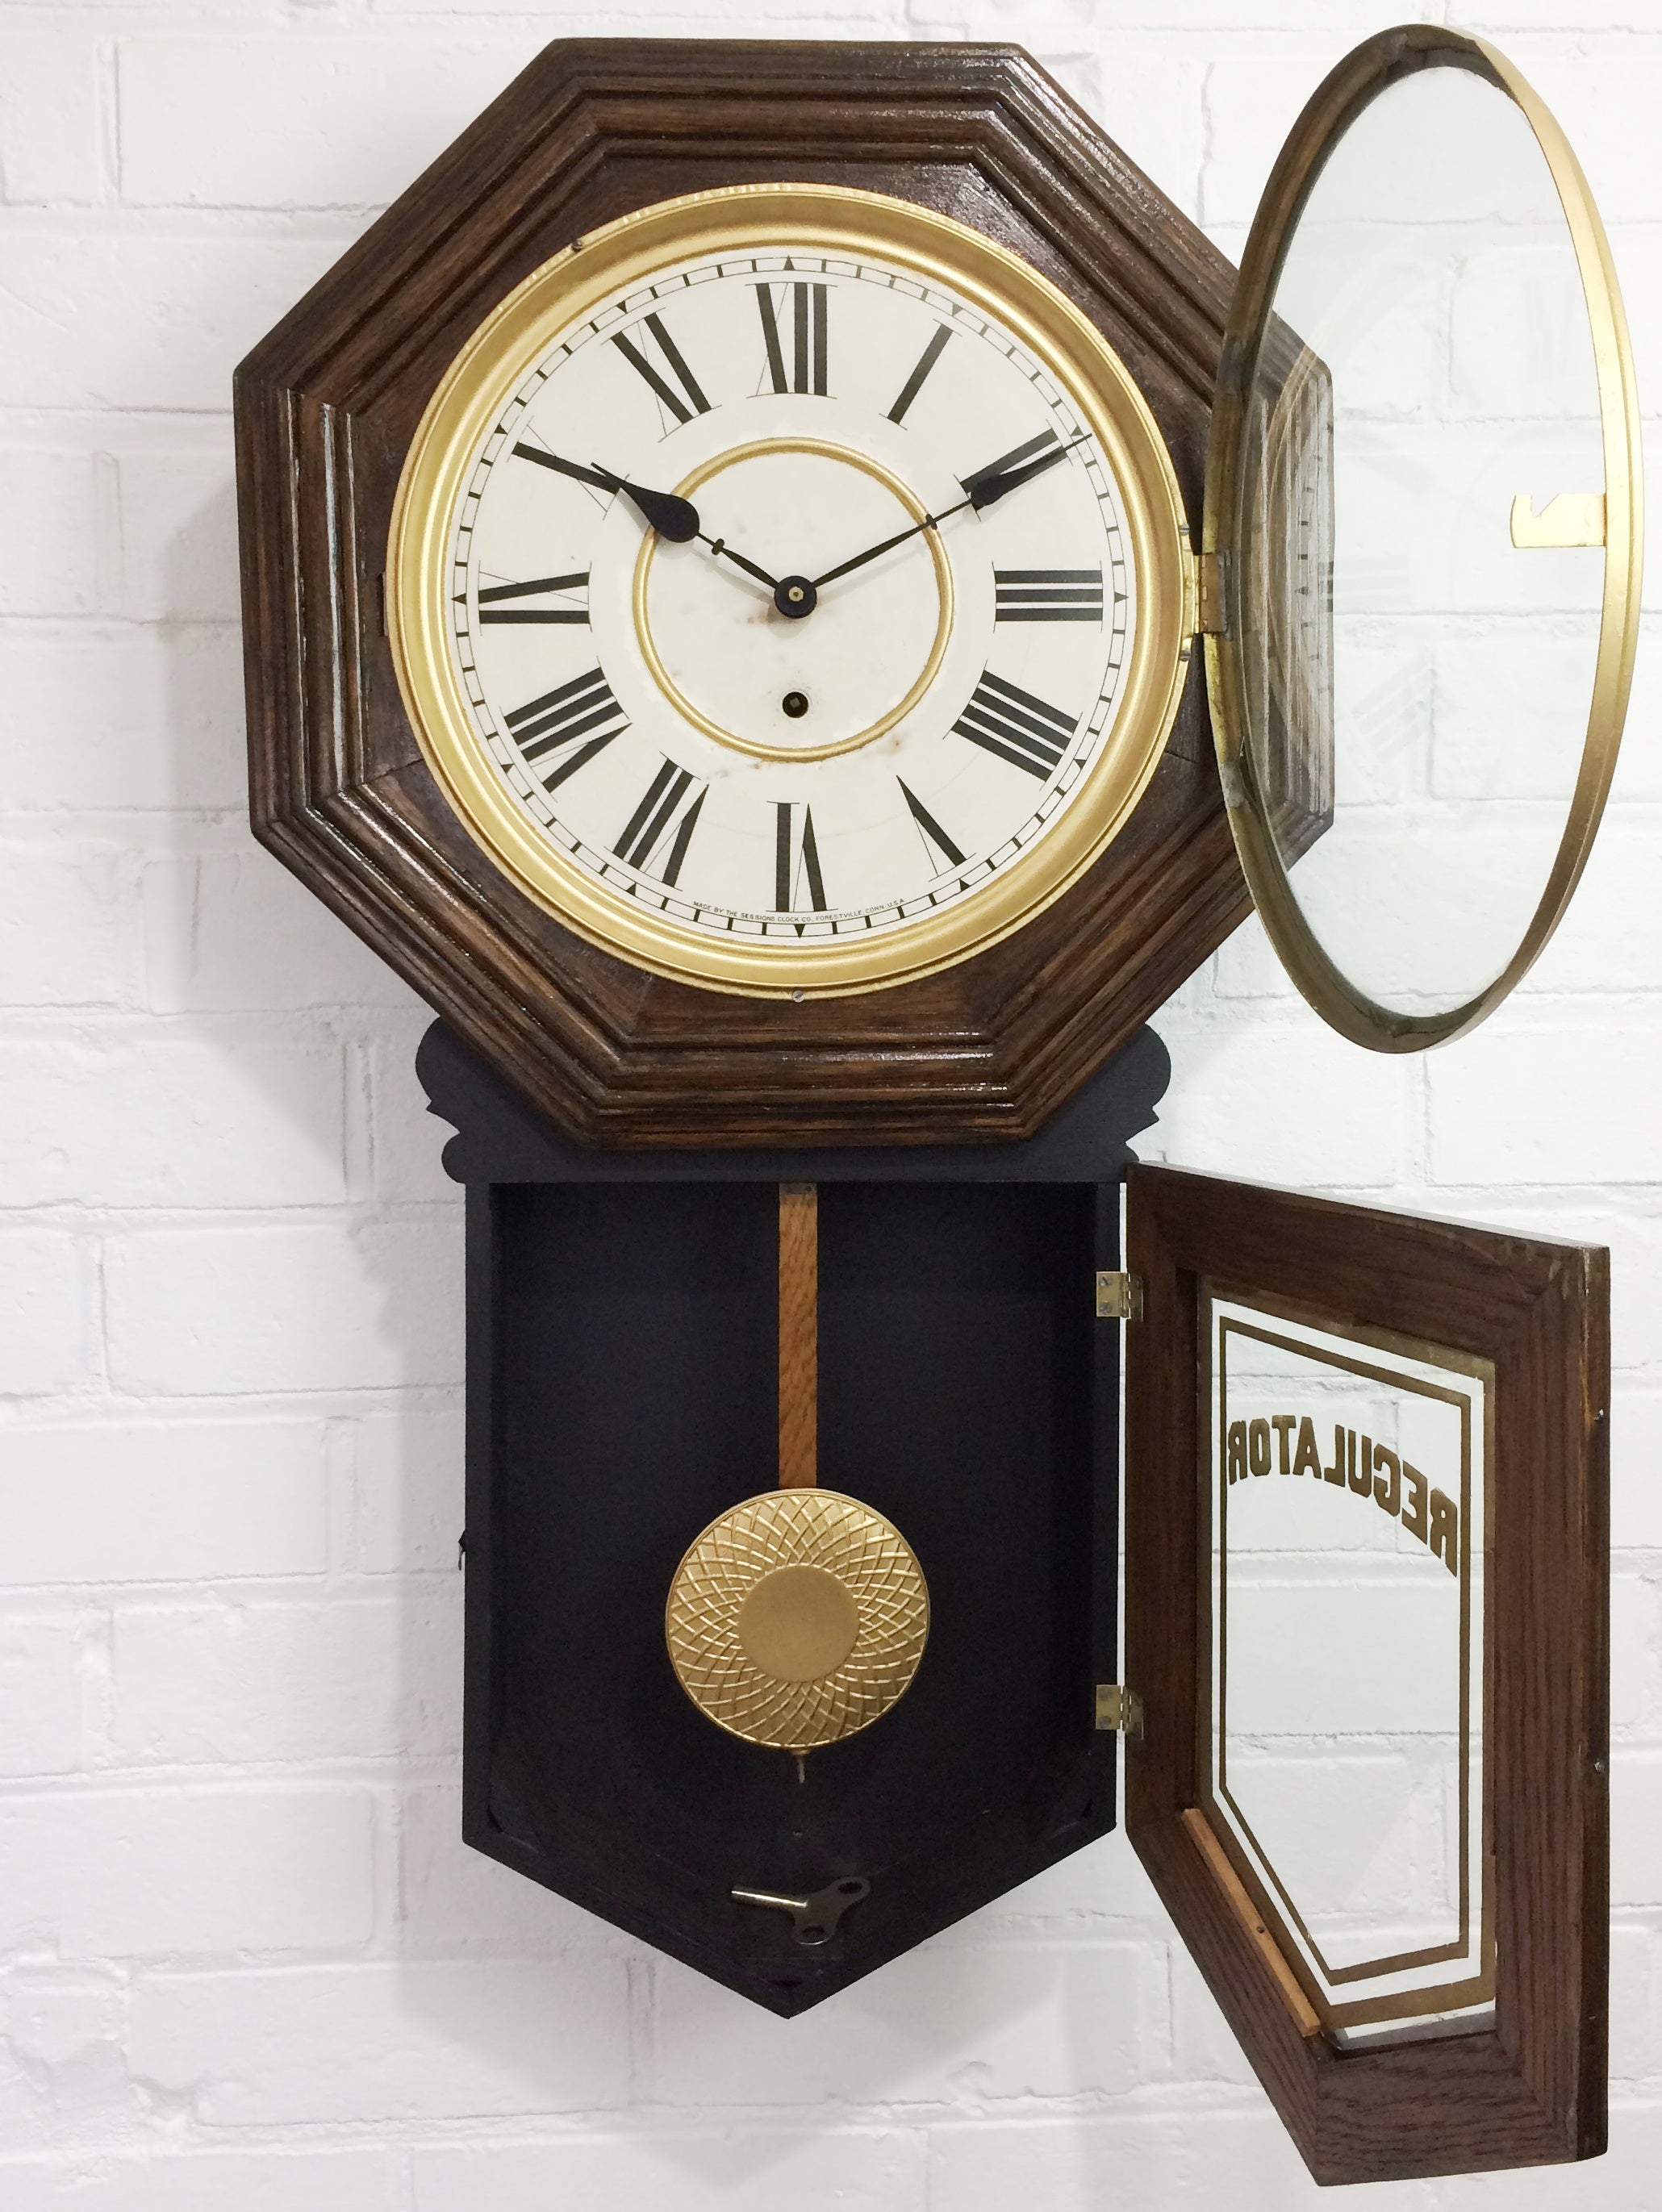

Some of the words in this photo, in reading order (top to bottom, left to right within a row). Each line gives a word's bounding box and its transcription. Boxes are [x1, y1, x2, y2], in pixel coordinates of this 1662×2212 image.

[601, 307, 723, 444] XI
[745, 279, 838, 400] XII
[879, 319, 963, 432] I
[507, 415, 630, 521] X
[478, 560, 592, 633] IX
[991, 561, 1105, 632] III
[498, 655, 633, 804] VIII
[942, 660, 1084, 792] IIII
[603, 751, 709, 892] VII
[766, 800, 839, 913] VI
[896, 774, 977, 878] V
[693, 900, 712, 911] MADE
[726, 909, 738, 917] THE
[741, 912, 775, 922] SESSIONS
